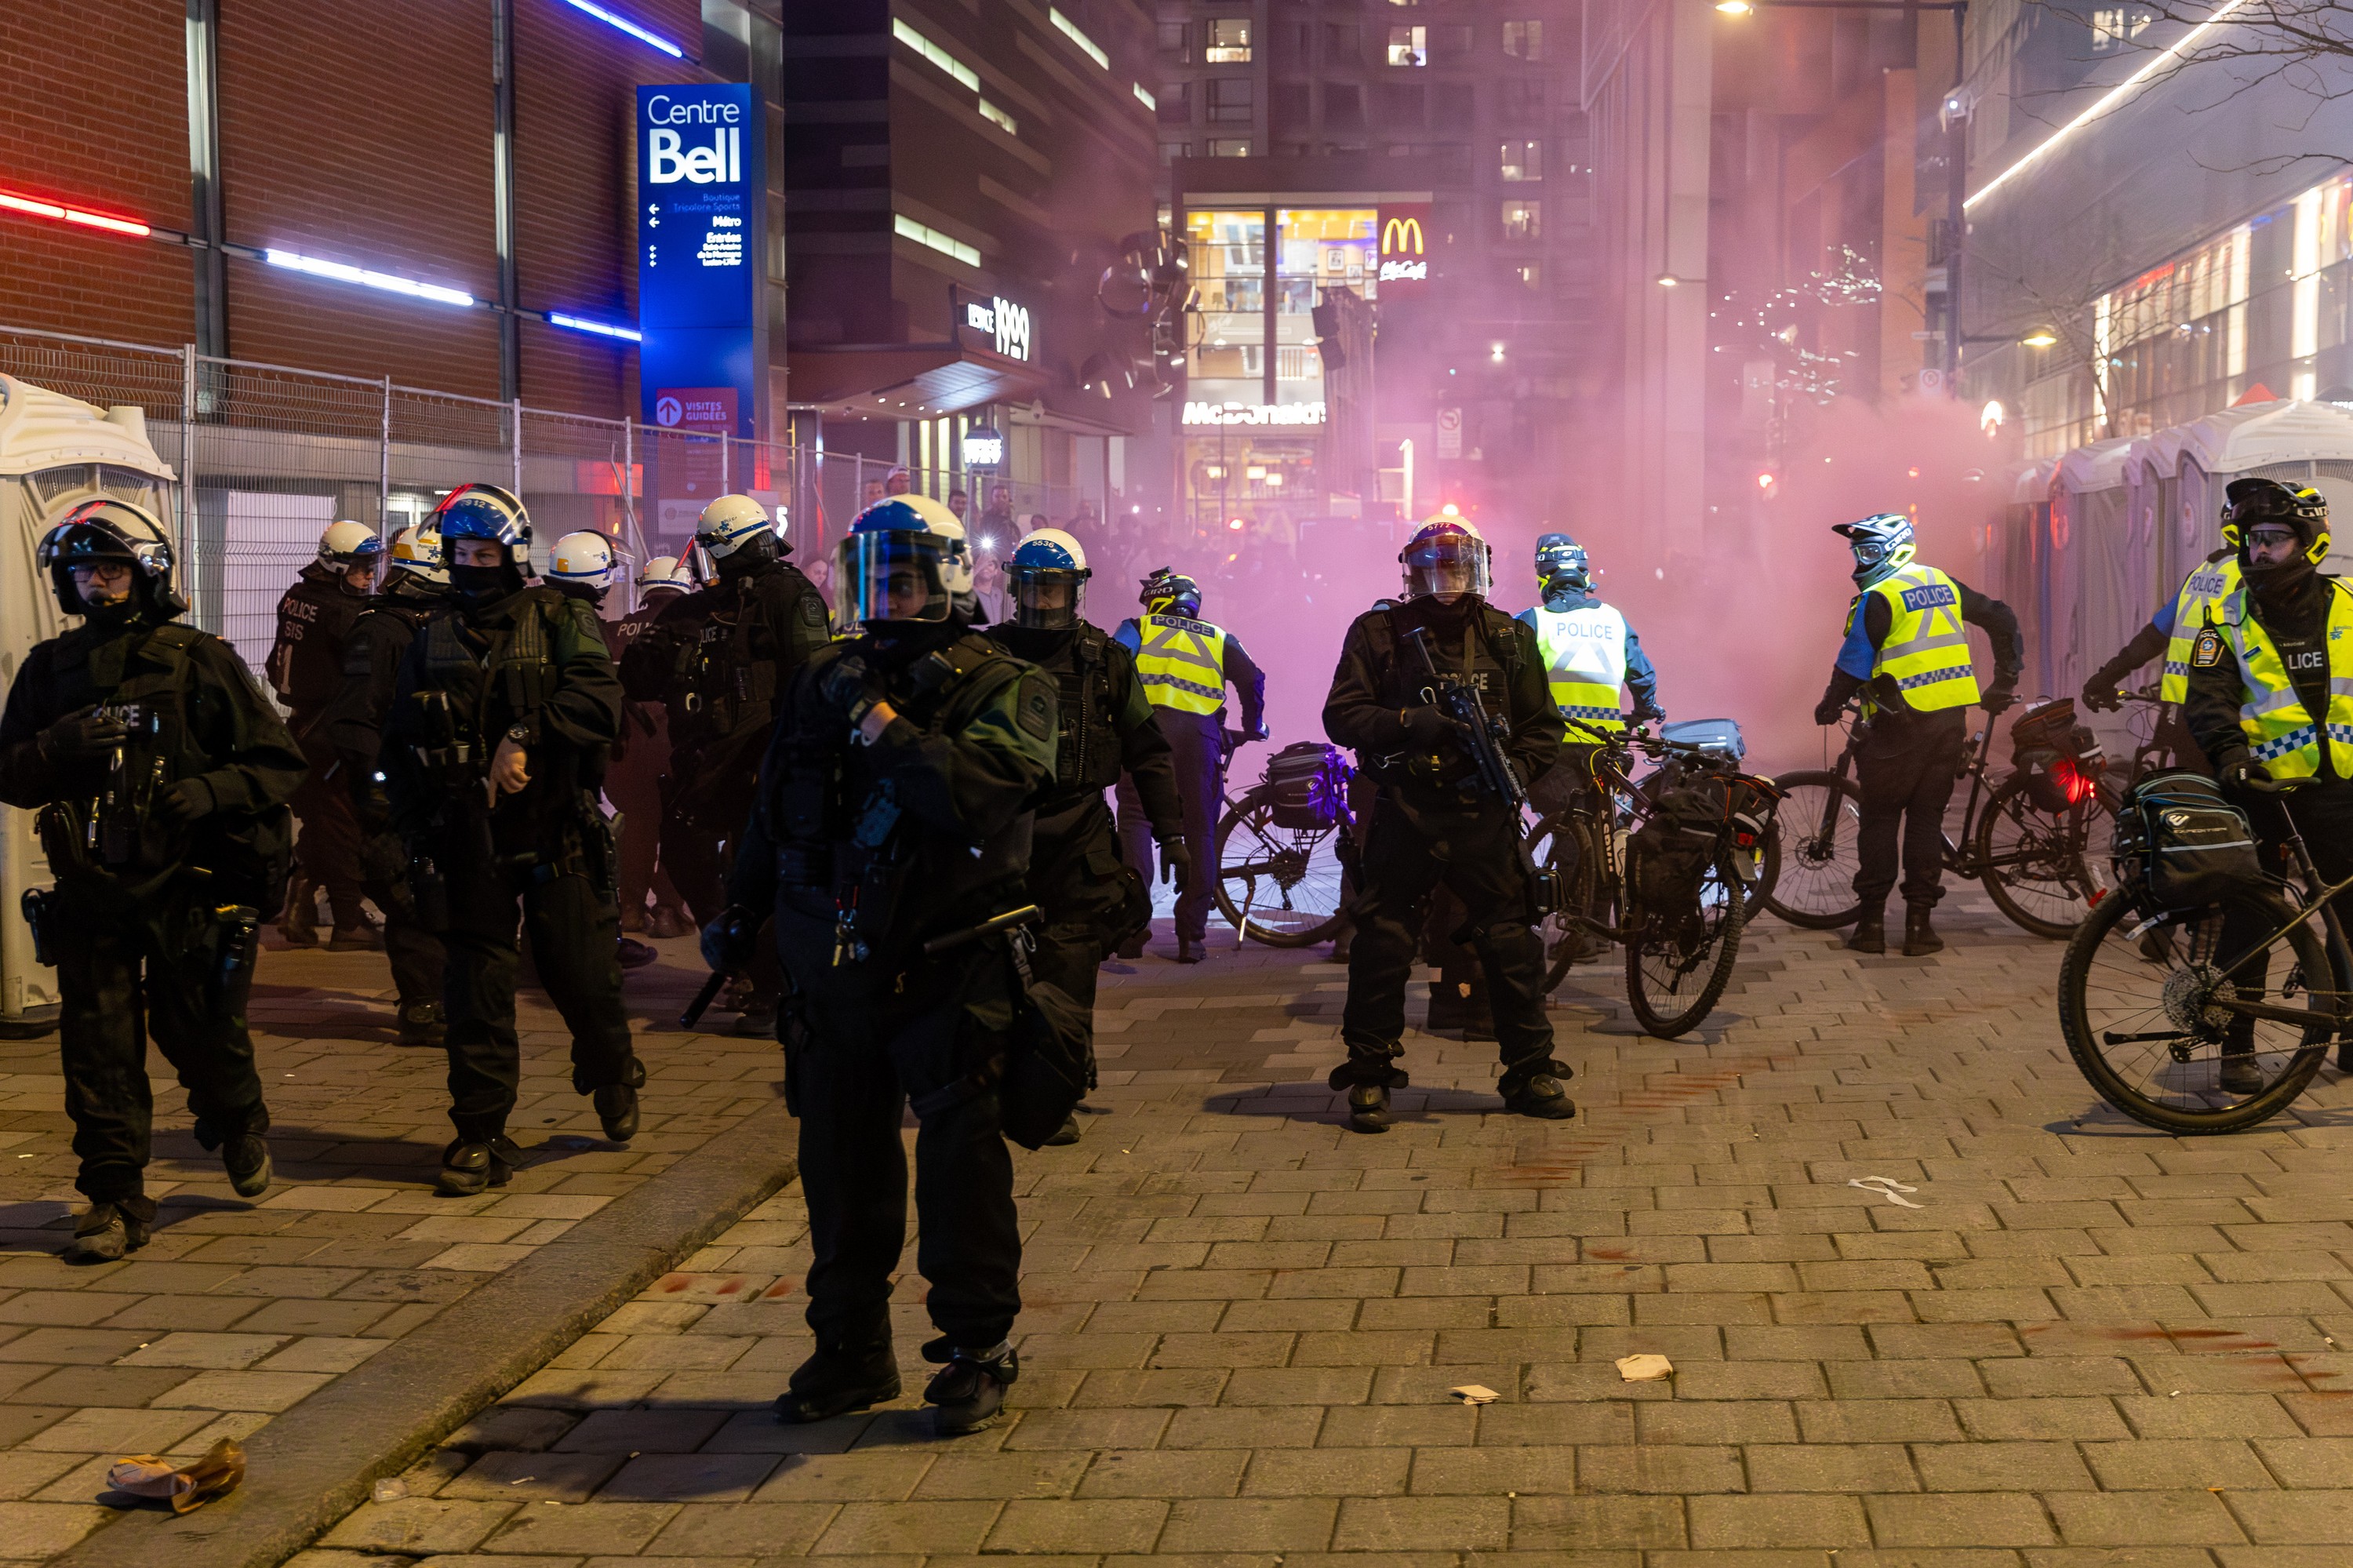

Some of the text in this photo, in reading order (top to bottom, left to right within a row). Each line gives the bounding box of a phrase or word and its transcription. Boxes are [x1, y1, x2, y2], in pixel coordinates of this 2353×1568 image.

[648, 95, 740, 125] Centre
[649, 127, 740, 184] Bell
[703, 194, 740, 203] Boutique
[993, 297, 1029, 361] 1909
[686, 402, 722, 411] VISITES
[1884, 527, 1912, 551] GIRO
[1144, 587, 1173, 596] GIRO
[2190, 575, 2224, 595] POLICE
[1904, 587, 1954, 609] POLICE
[282, 597, 318, 623] POLICE
[285, 620, 304, 641] SIS
[1155, 616, 1211, 635] POLICE
[1557, 622, 1613, 640] POLICE
